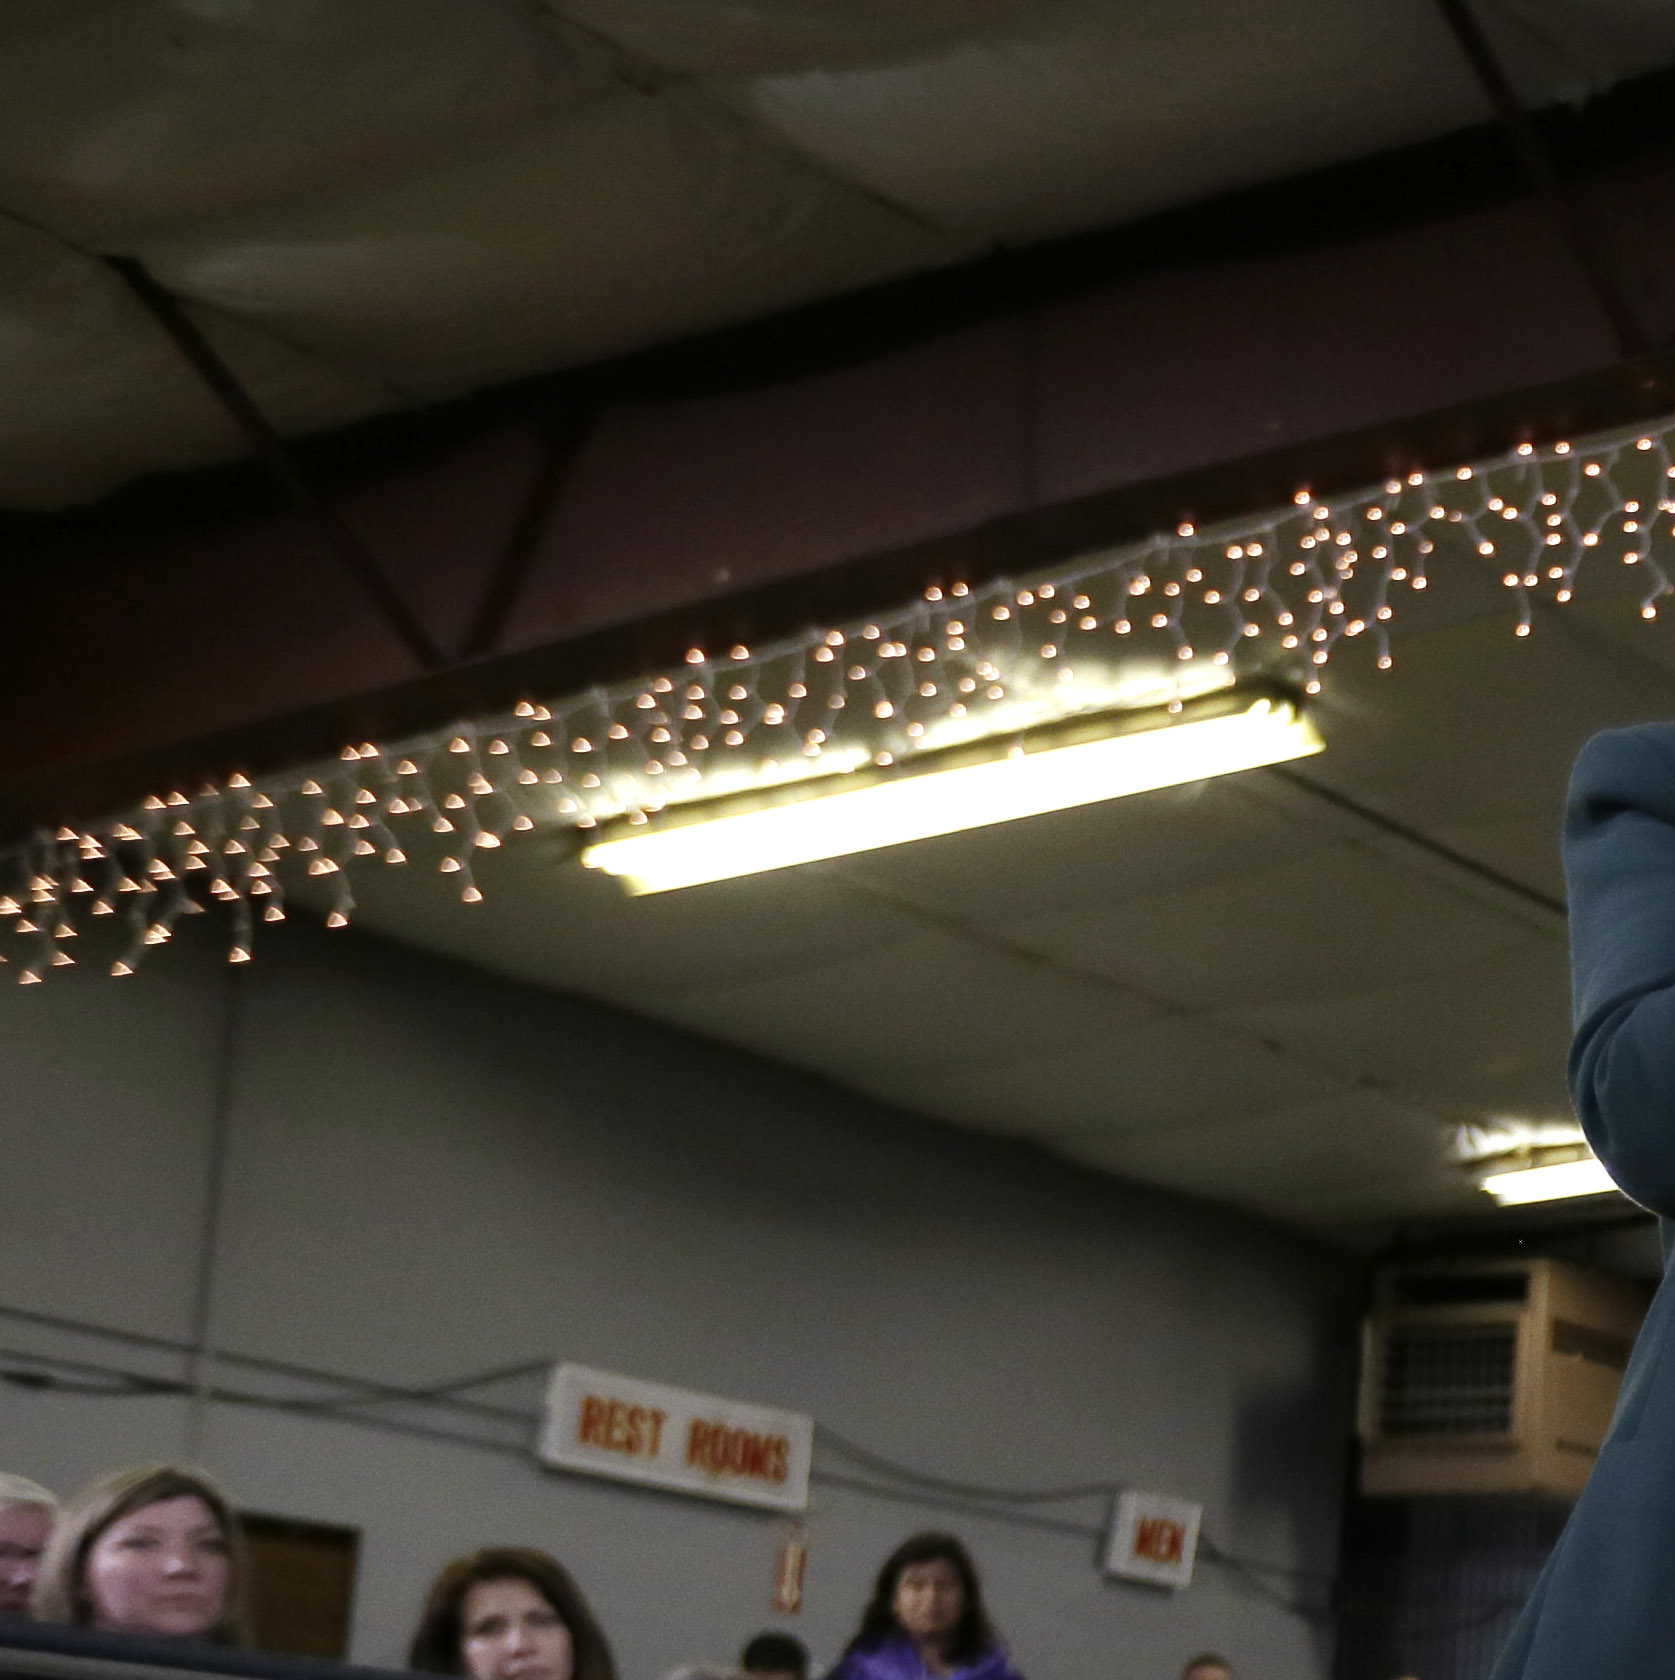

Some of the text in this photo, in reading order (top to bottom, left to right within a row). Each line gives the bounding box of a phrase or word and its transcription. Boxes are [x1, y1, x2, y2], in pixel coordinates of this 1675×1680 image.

[579, 1396, 790, 1482] REST ROOMS
[1136, 1517, 1185, 1563] MEN
